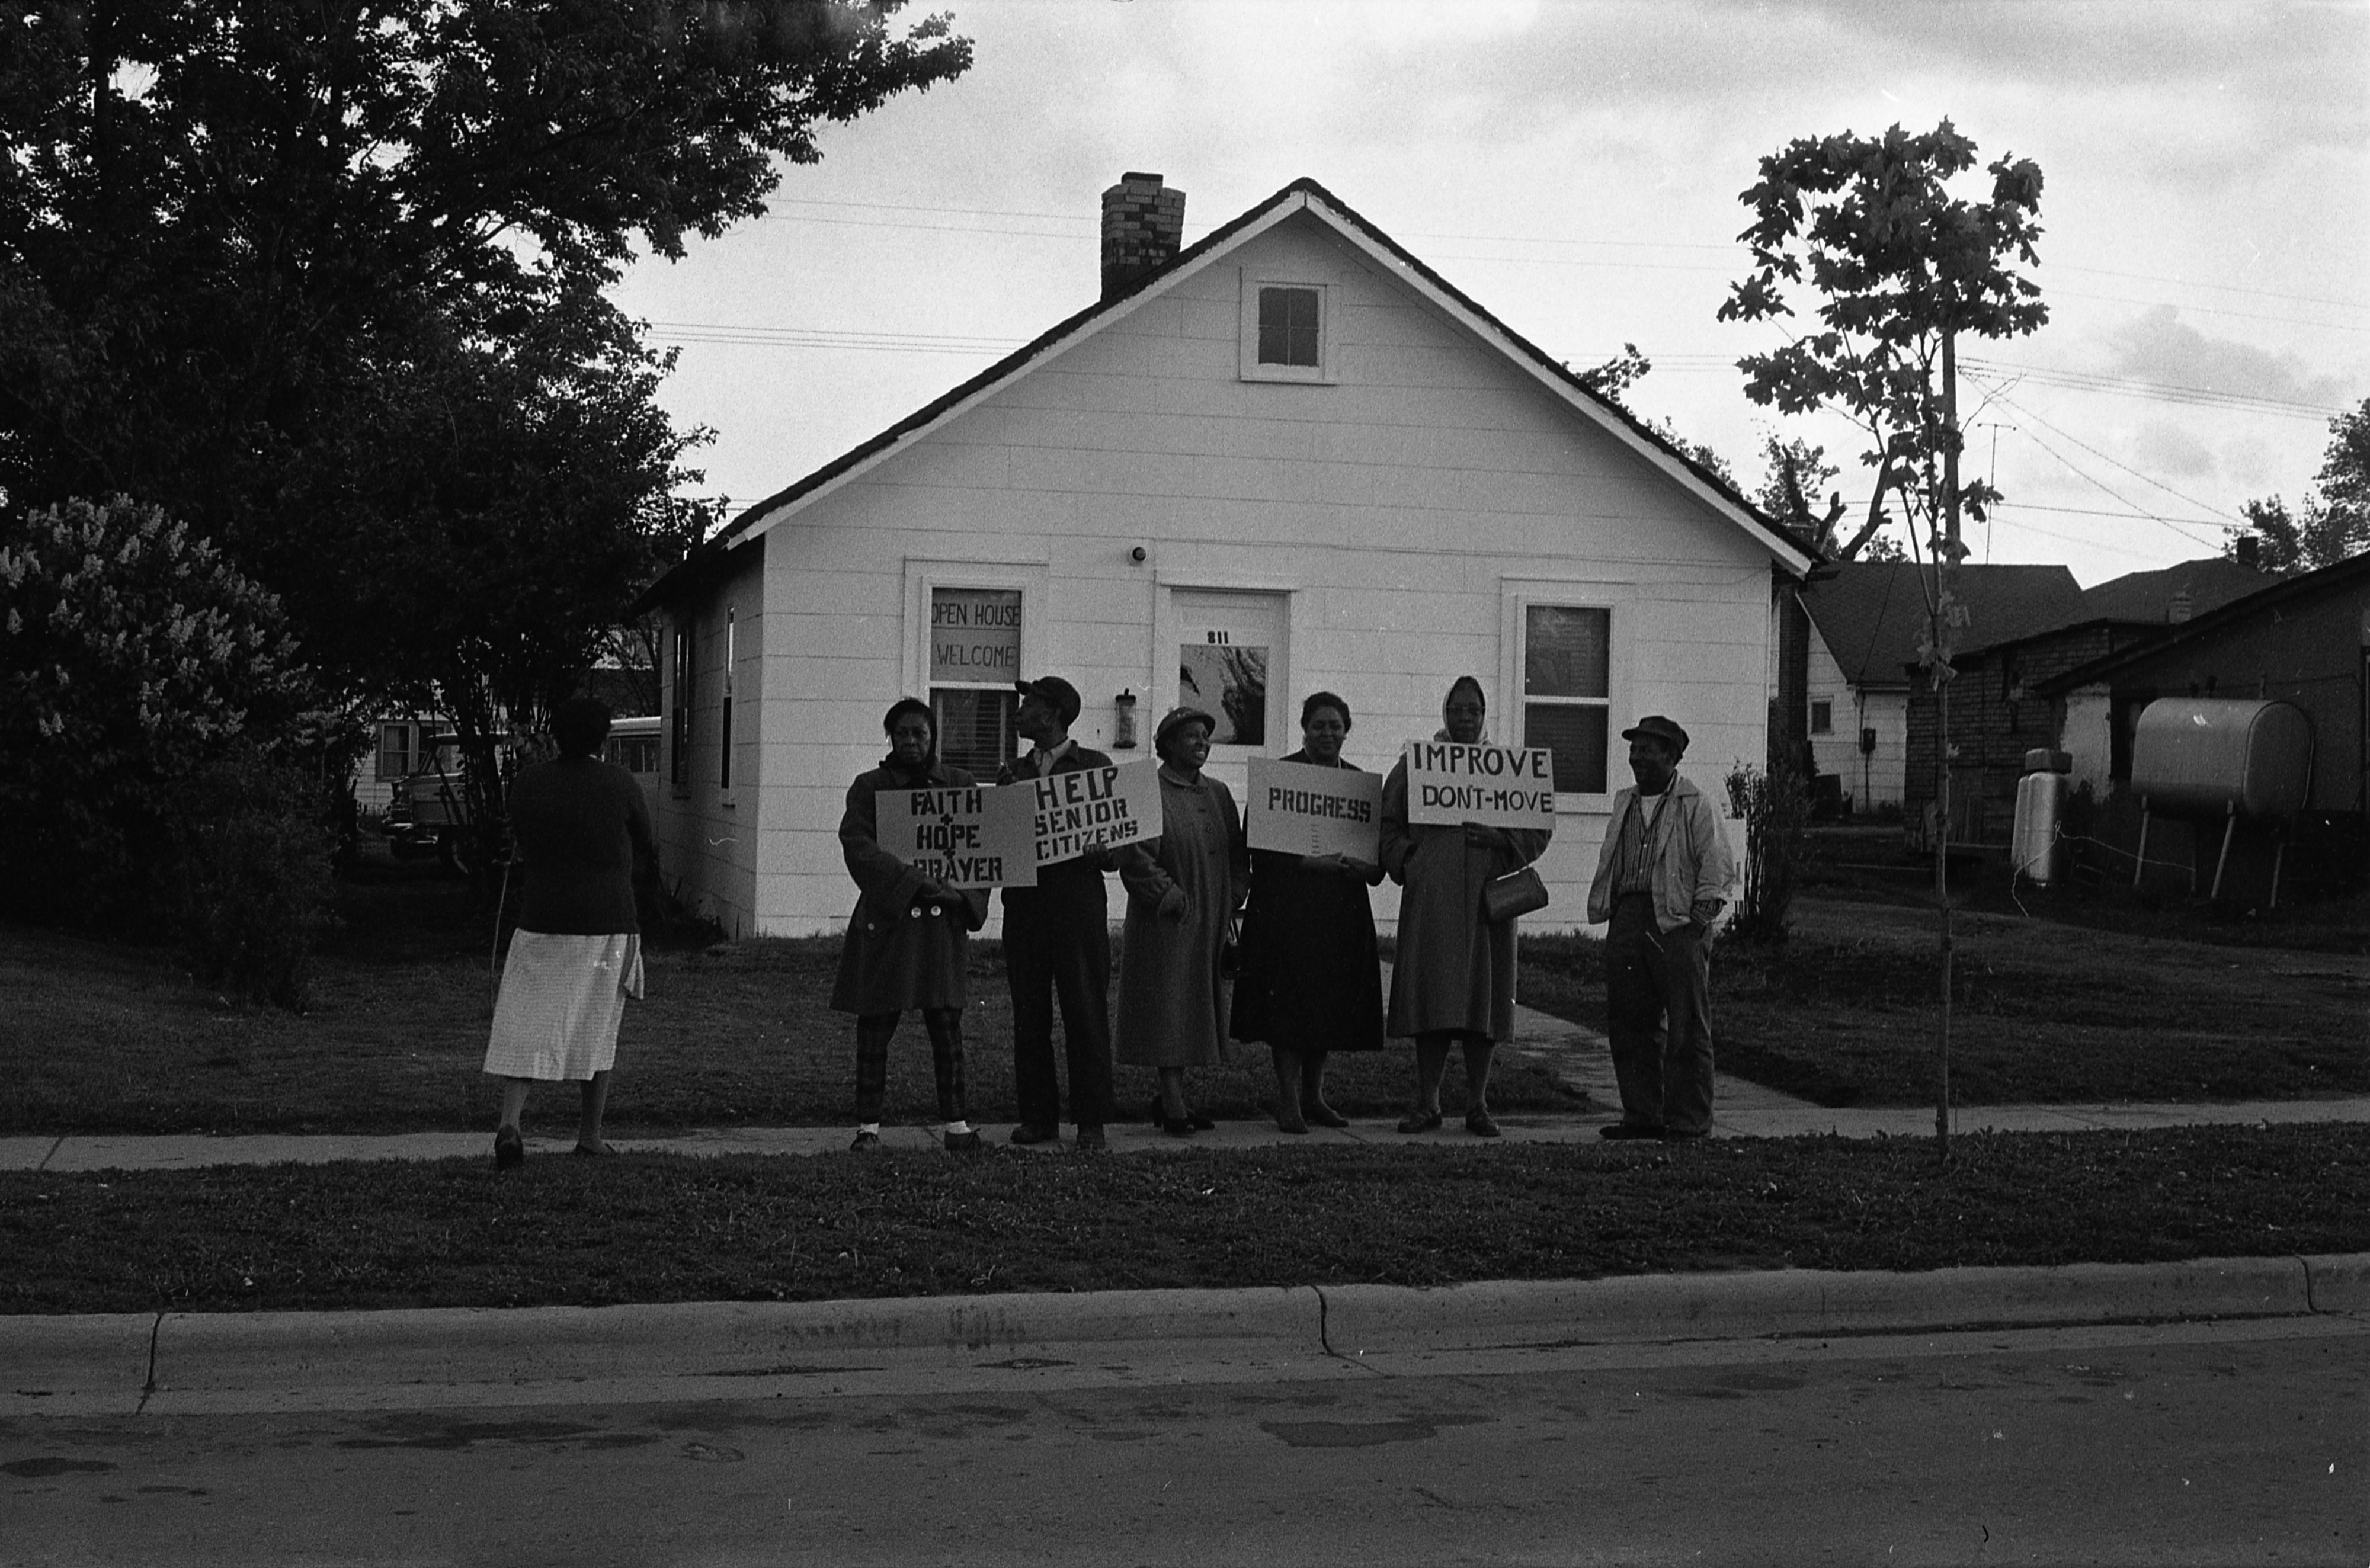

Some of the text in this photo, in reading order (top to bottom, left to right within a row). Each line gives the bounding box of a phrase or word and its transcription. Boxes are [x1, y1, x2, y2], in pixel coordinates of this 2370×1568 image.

[932, 603, 1021, 626] OPEN HOUSE
[1207, 631, 1228, 644] 811
[937, 644, 1017, 668] WELCOME
[1413, 743, 1549, 778] IMPROVE
[911, 789, 982, 815] FAITH
[1035, 767, 1119, 810] HELP
[1035, 798, 1128, 836] SENIOR
[1269, 787, 1372, 823] PROGRESS
[917, 824, 981, 850] HOPE
[1036, 820, 1138, 860] CITIZENS
